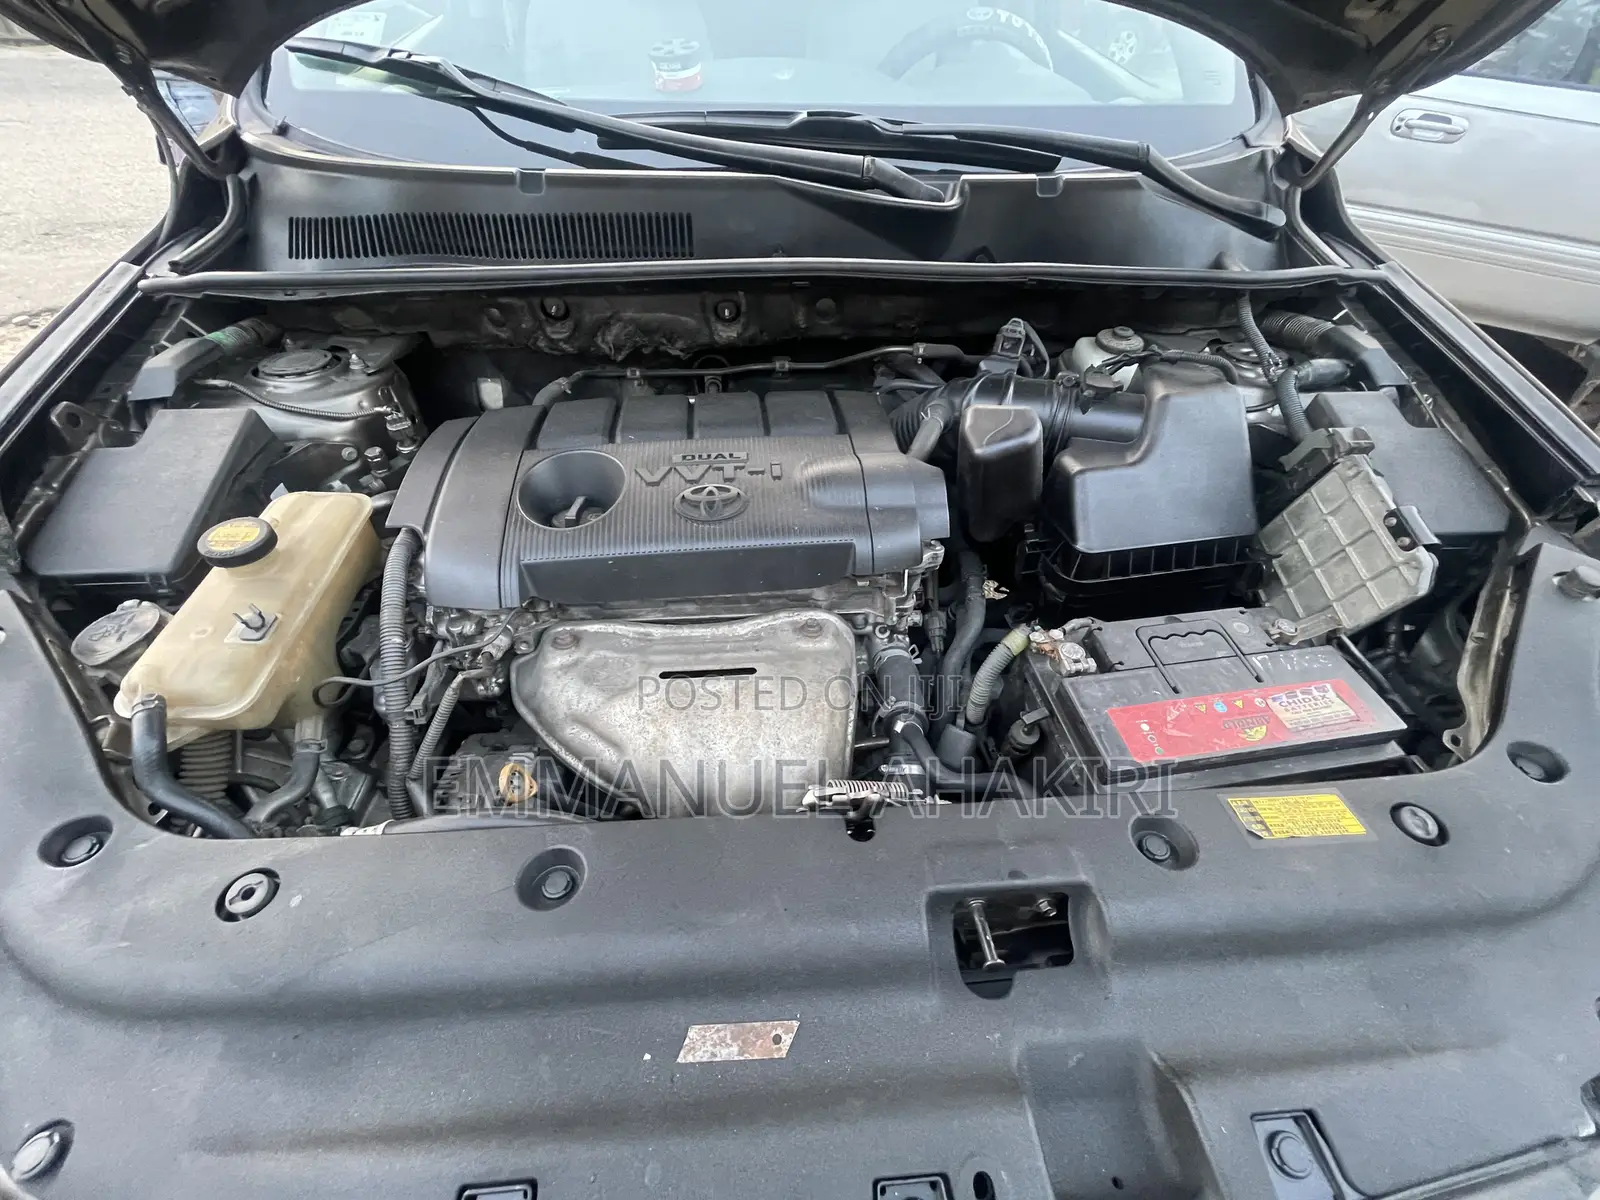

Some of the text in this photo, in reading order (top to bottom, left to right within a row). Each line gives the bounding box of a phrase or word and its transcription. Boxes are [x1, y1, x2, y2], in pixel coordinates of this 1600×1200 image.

[681, 452, 741, 461] DUAL
[1279, 694, 1331, 708] CHIDEX
[1283, 699, 1335, 713] BATTERIES
